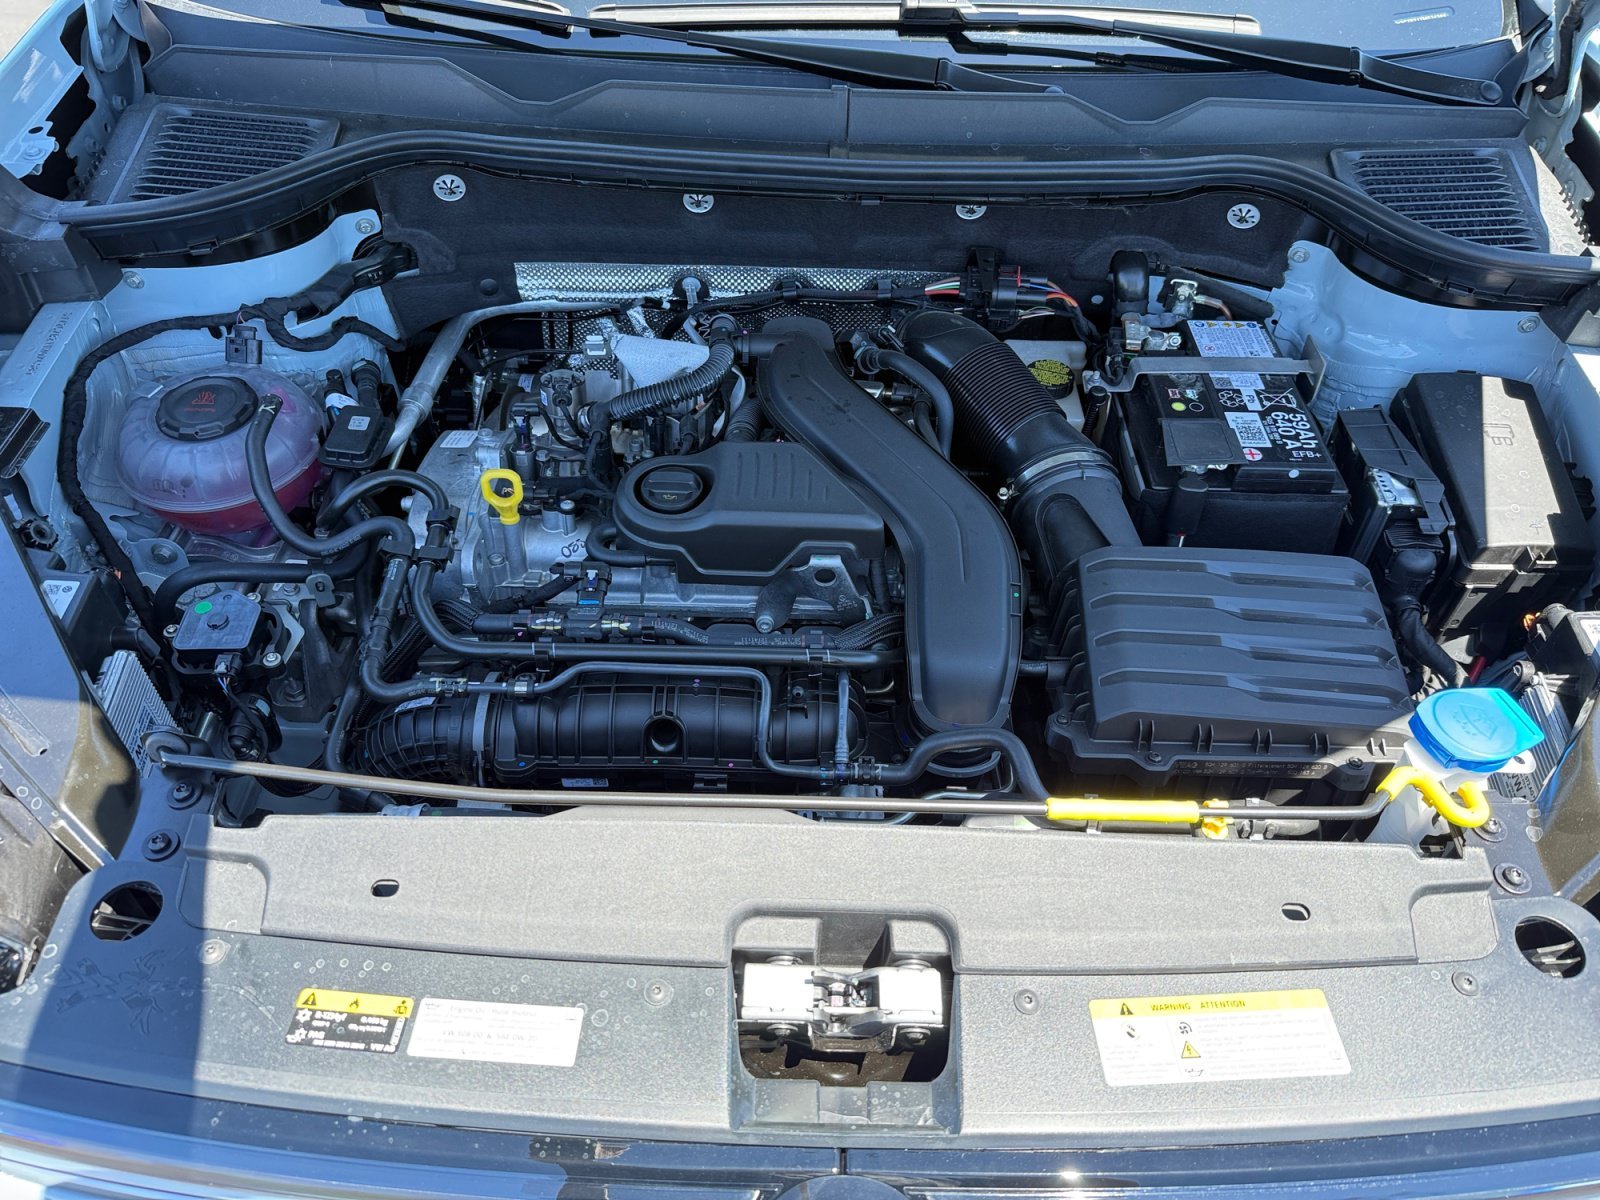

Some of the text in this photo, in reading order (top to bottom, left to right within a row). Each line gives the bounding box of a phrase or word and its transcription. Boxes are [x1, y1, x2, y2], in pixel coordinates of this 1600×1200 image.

[1245, 394, 1255, 404] Pb
[1271, 411, 1296, 436] 640
[1289, 413, 1319, 448] 59Ah
[1282, 439, 1302, 450] A
[1291, 450, 1322, 458] EFB+
[1151, 1000, 1246, 1012] WARNING ATTENTION
